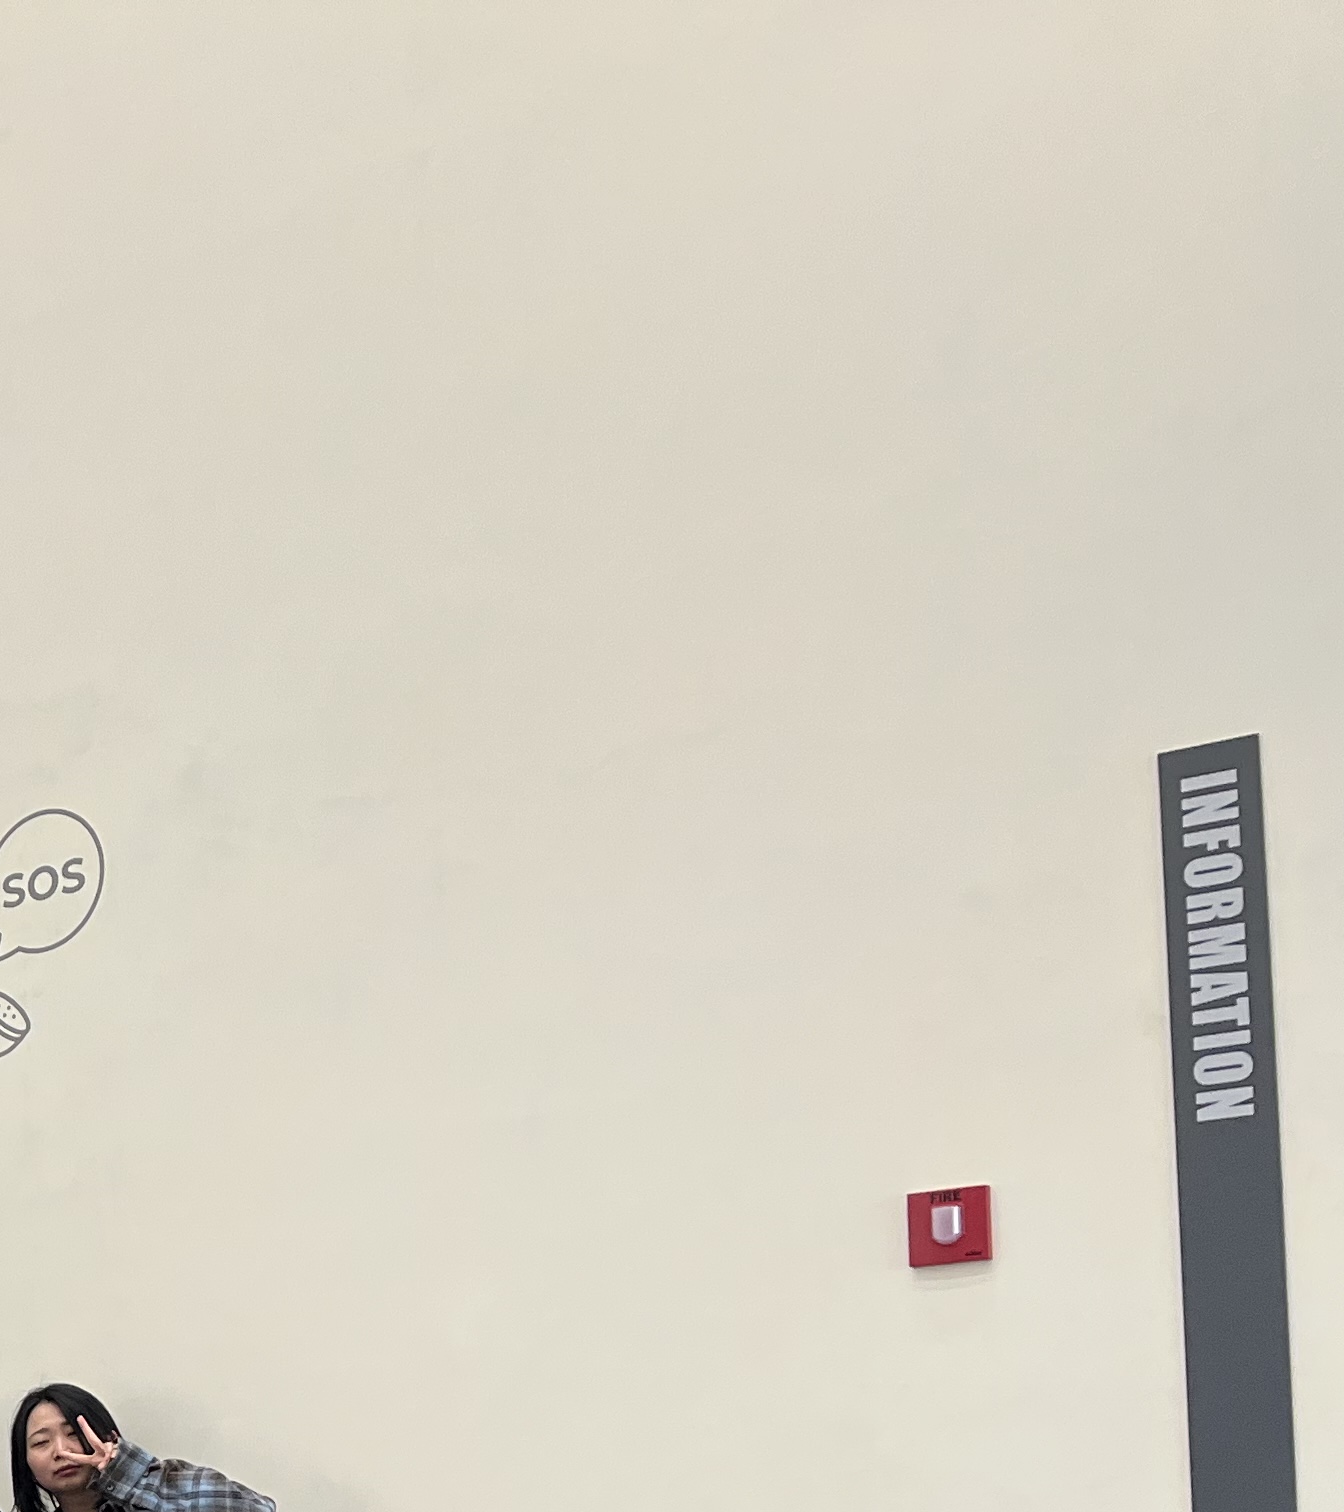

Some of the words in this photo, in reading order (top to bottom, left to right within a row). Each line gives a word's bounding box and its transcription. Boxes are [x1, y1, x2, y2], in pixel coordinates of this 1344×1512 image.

[2, 857, 86, 908] SOS
[1180, 768, 1255, 1122] INFORMATION
[930, 1190, 961, 1204] FIRE
